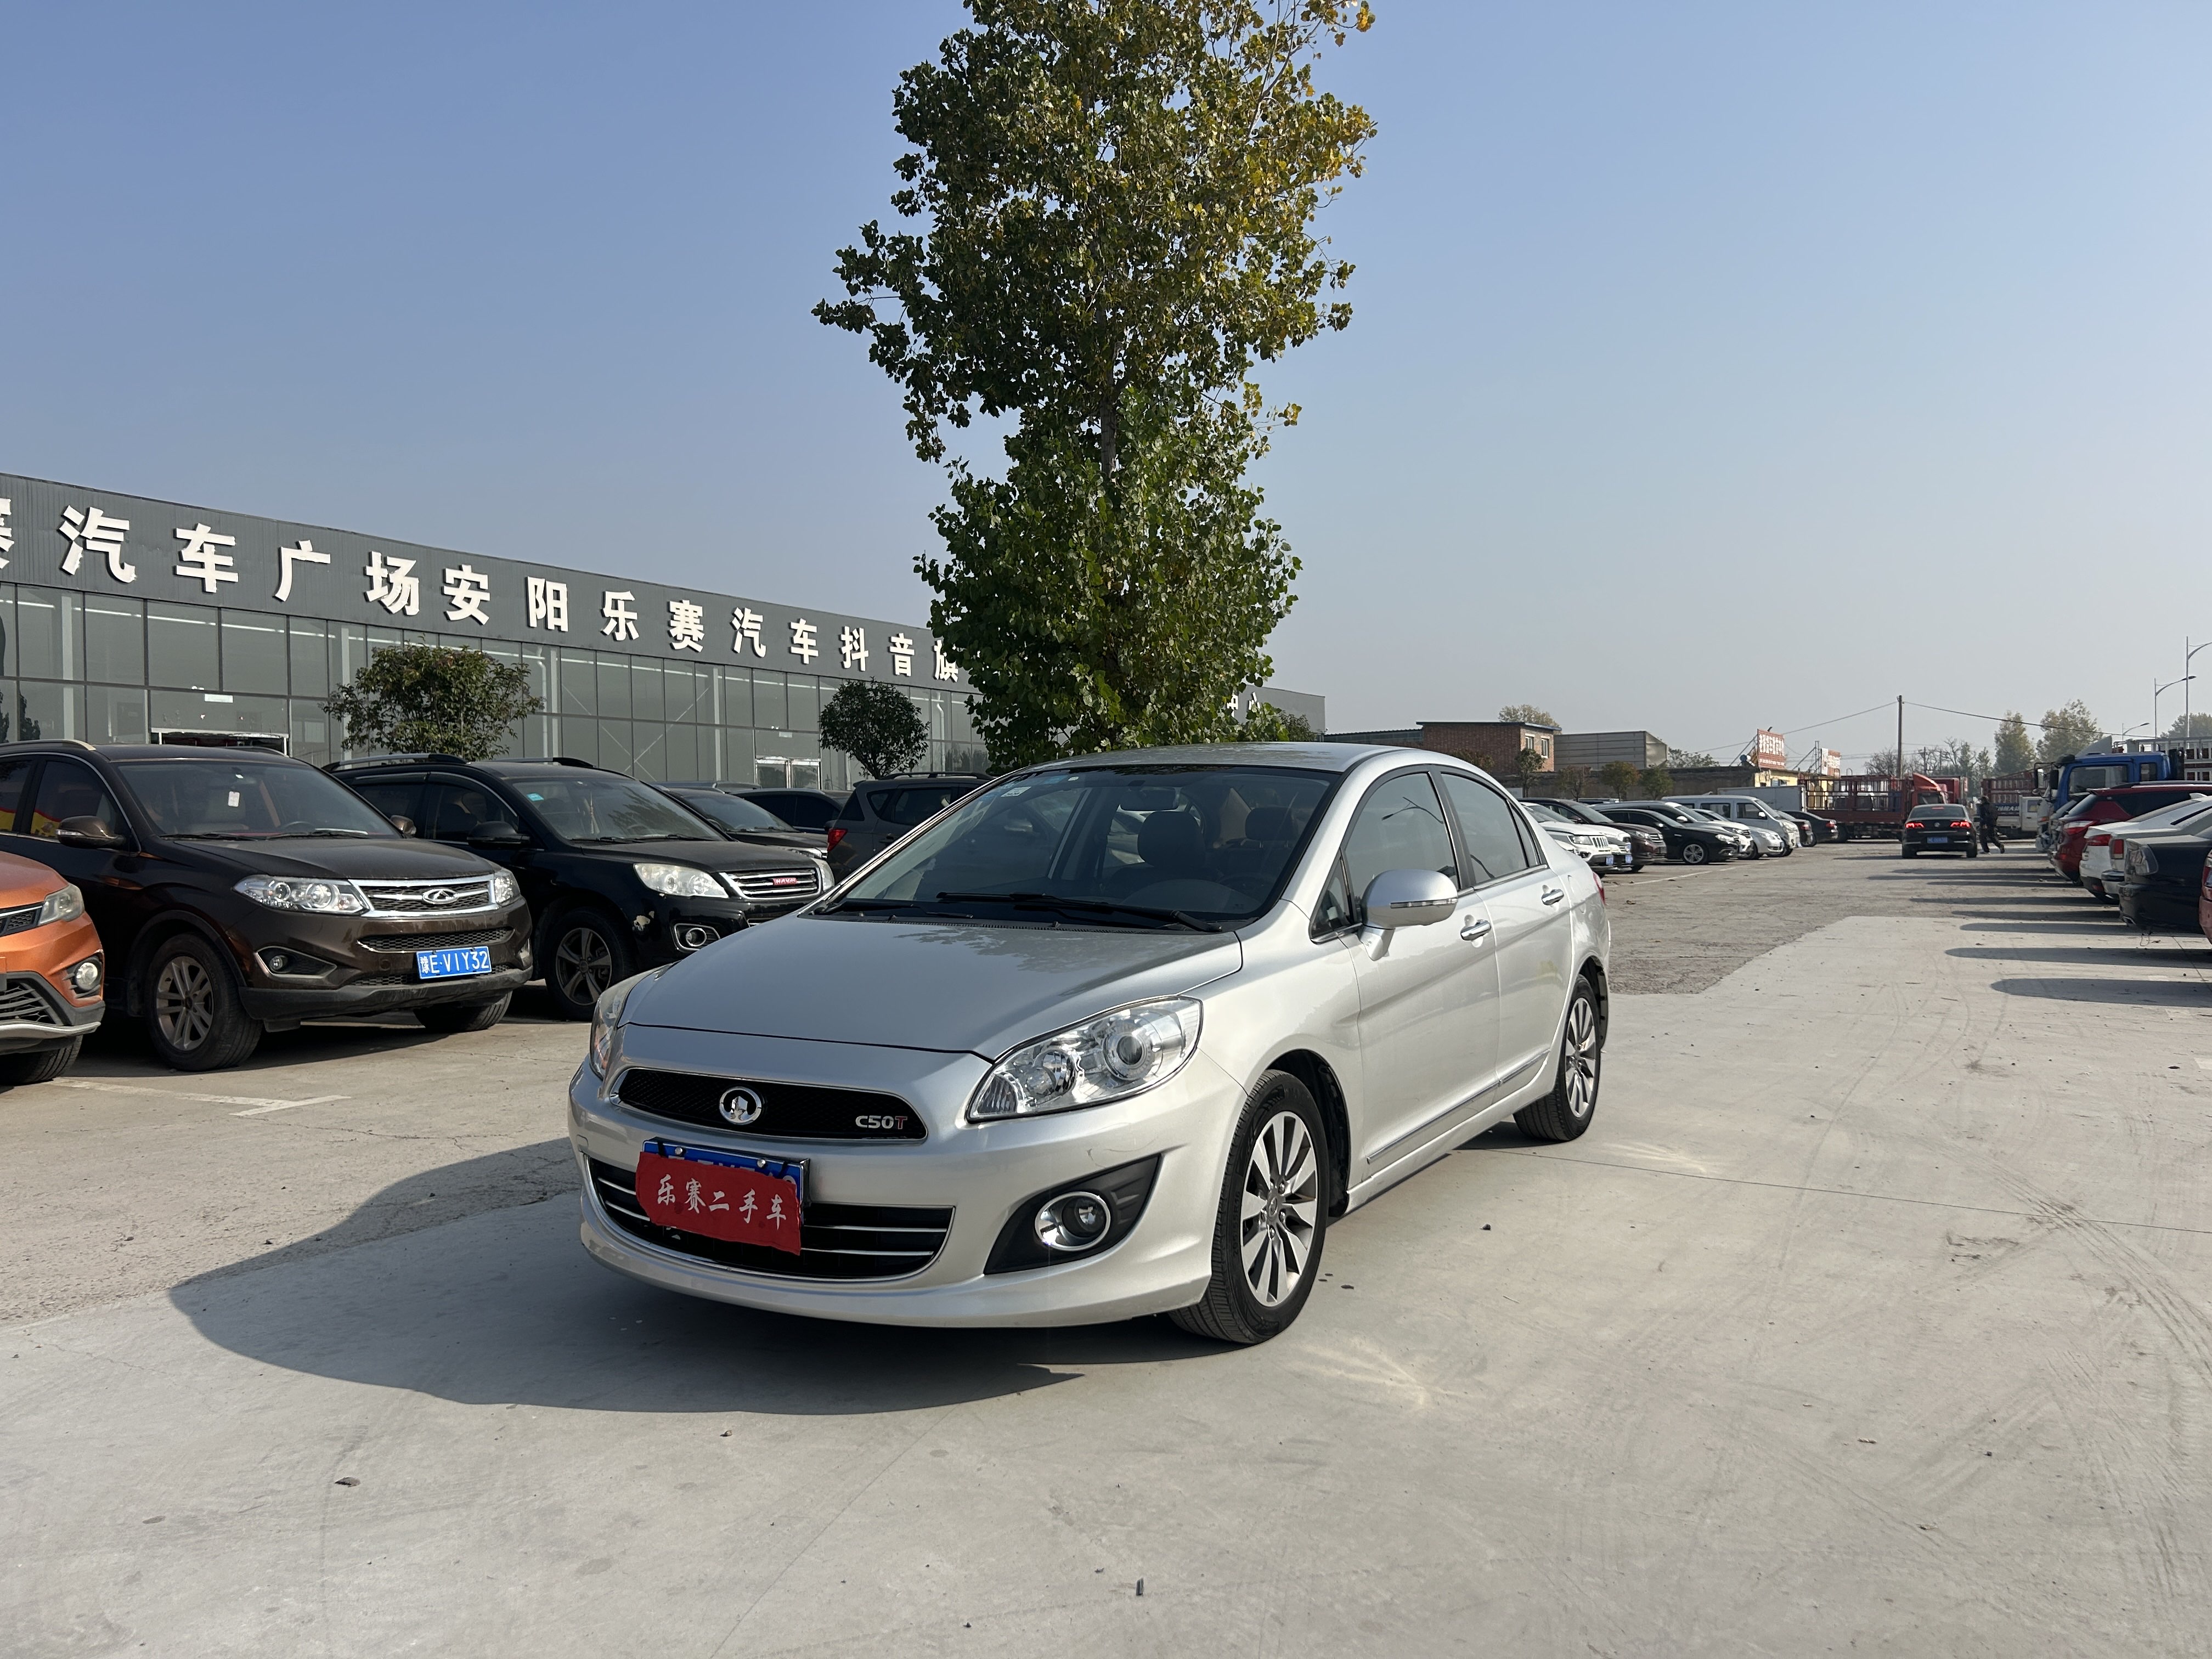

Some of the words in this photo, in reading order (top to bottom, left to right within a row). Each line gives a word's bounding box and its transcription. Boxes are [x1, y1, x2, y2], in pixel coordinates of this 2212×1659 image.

[855, 1115, 908, 1130] C50T
[657, 1173, 787, 1230] 乐赛二手车
